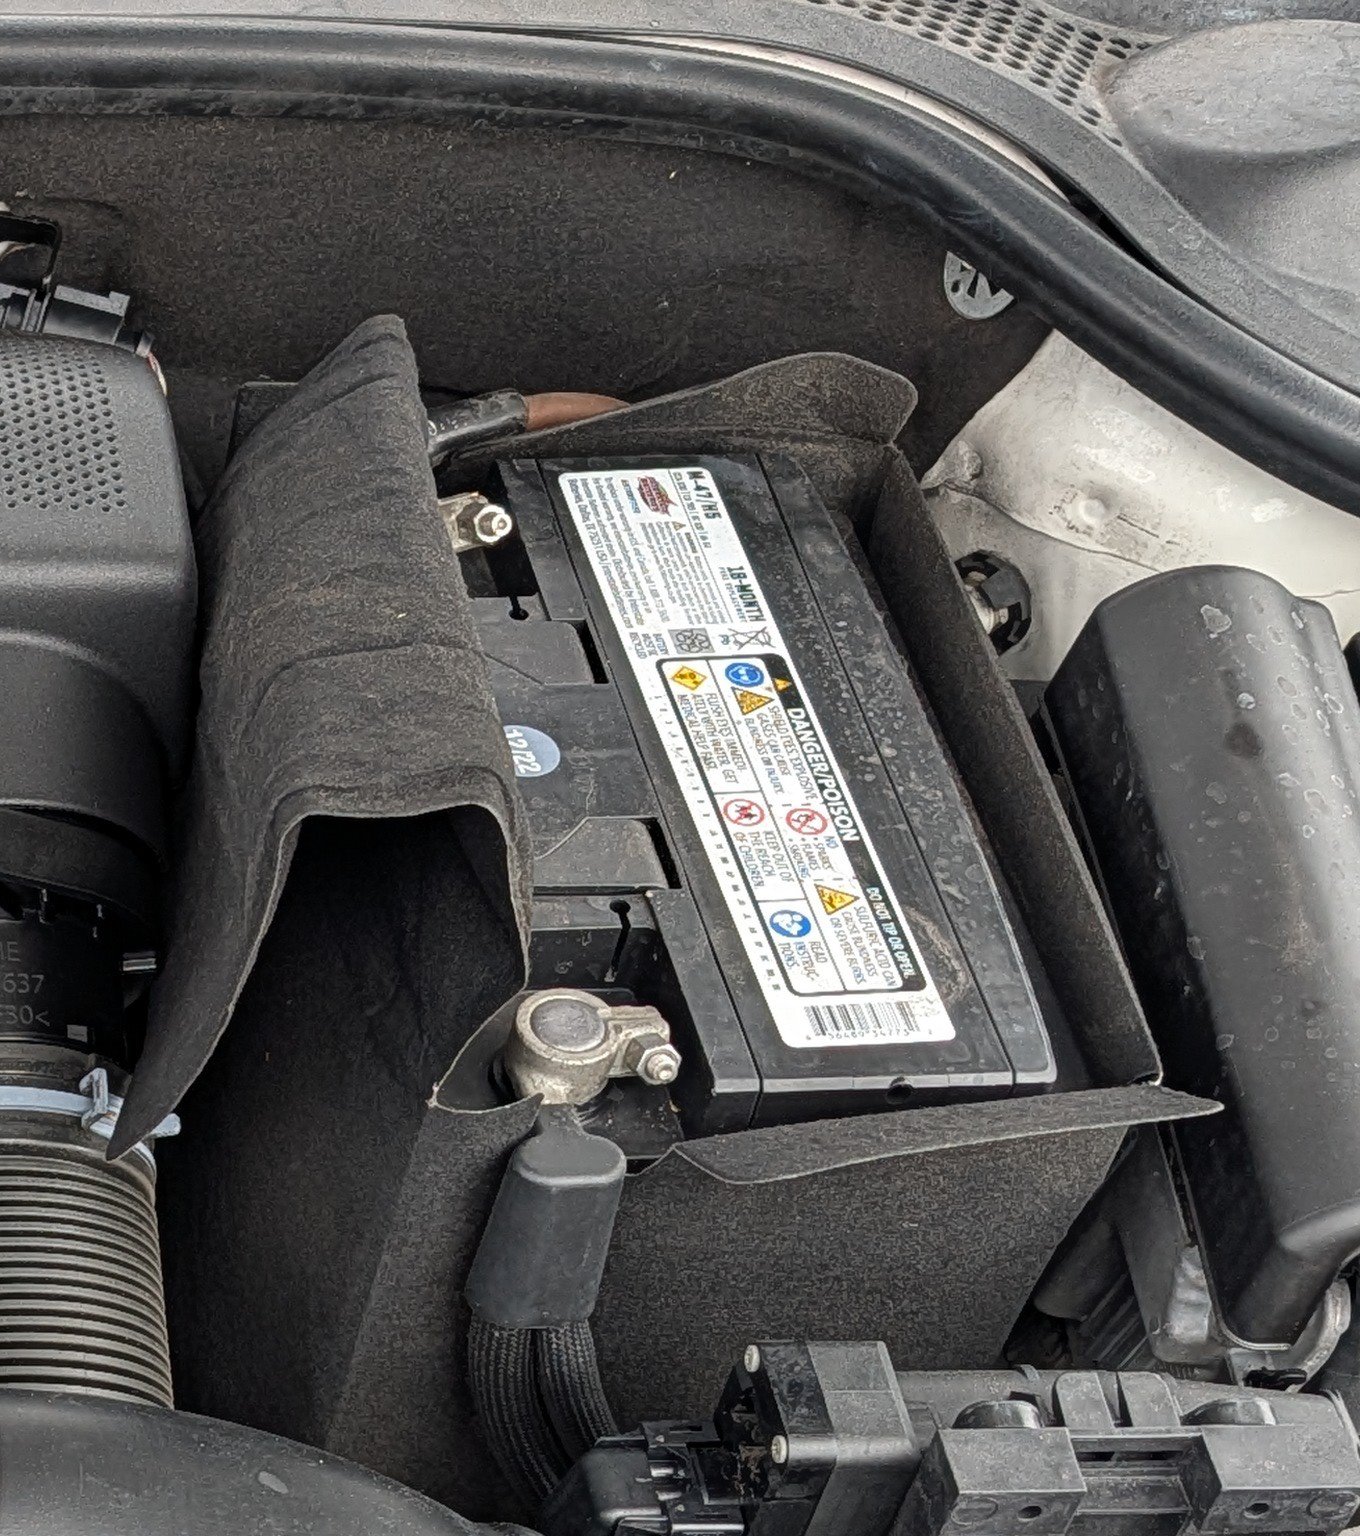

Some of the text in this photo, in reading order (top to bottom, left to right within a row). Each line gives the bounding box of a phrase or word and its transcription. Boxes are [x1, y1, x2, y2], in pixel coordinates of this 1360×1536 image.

[727, 566, 765, 621] 18-MONTH
[705, 692, 724, 717] FLUSH
[677, 694, 700, 728] MEDICAL
[691, 729, 709, 749] HELP
[756, 712, 775, 738] GASES
[766, 739, 780, 753] CAN
[506, 729, 541, 774] 12/22
[721, 768, 738, 783] GET
[788, 708, 858, 840] DANGER/POISON
[789, 756, 817, 799] EXPLOSIVE
[733, 831, 748, 843] OF
[823, 835, 838, 849] NO
[748, 830, 775, 876] THE REACH
[762, 830, 794, 882] KEEP OUT OF
[866, 887, 882, 900] DO
[873, 902, 891, 919] NOT
[881, 921, 897, 935] TIP
[809, 940, 827, 963] READ
[888, 936, 904, 949] OR
[872, 948, 889, 968] ACID
[881, 970, 897, 986] CAN
[3, 973, 44, 994] 637
